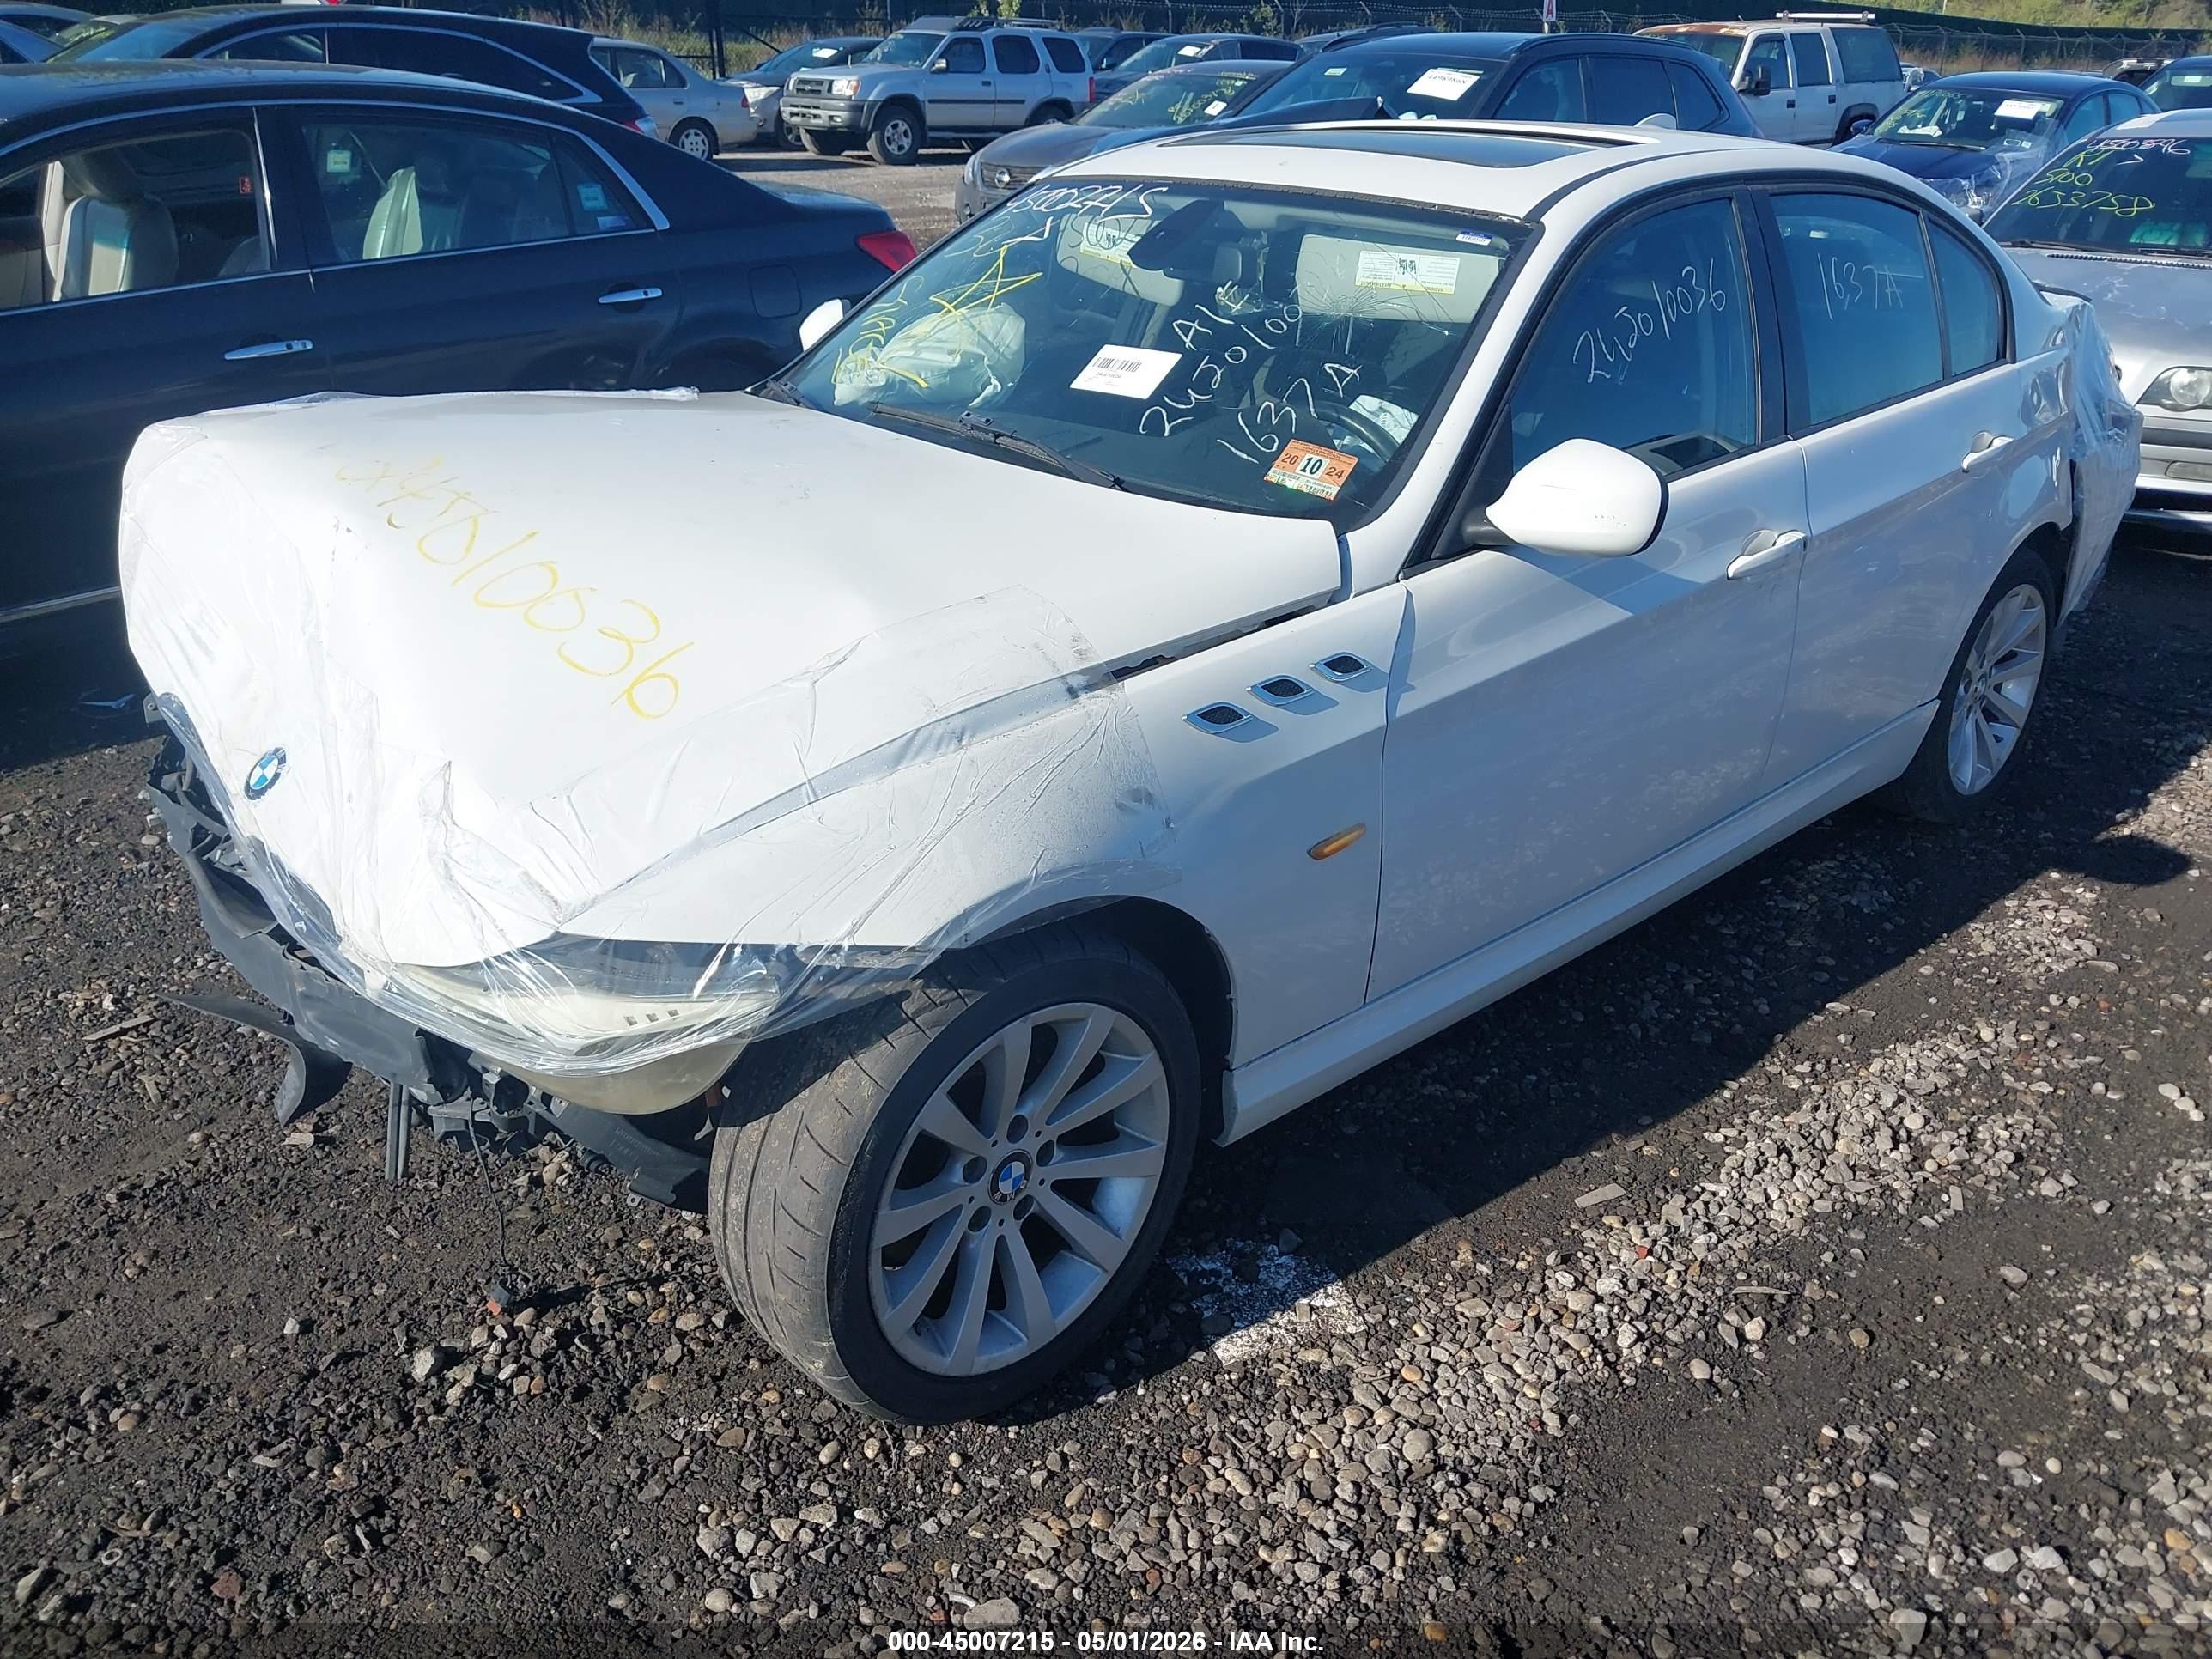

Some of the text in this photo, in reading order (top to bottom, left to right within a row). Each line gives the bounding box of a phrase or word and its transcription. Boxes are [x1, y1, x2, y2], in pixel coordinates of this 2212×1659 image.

[1816, 252, 1904, 321] 1637A
[1217, 362, 1364, 465] 1637A
[1280, 453, 1299, 465] 20
[1299, 457, 1323, 475] 10
[1325, 466, 1345, 479] 24
